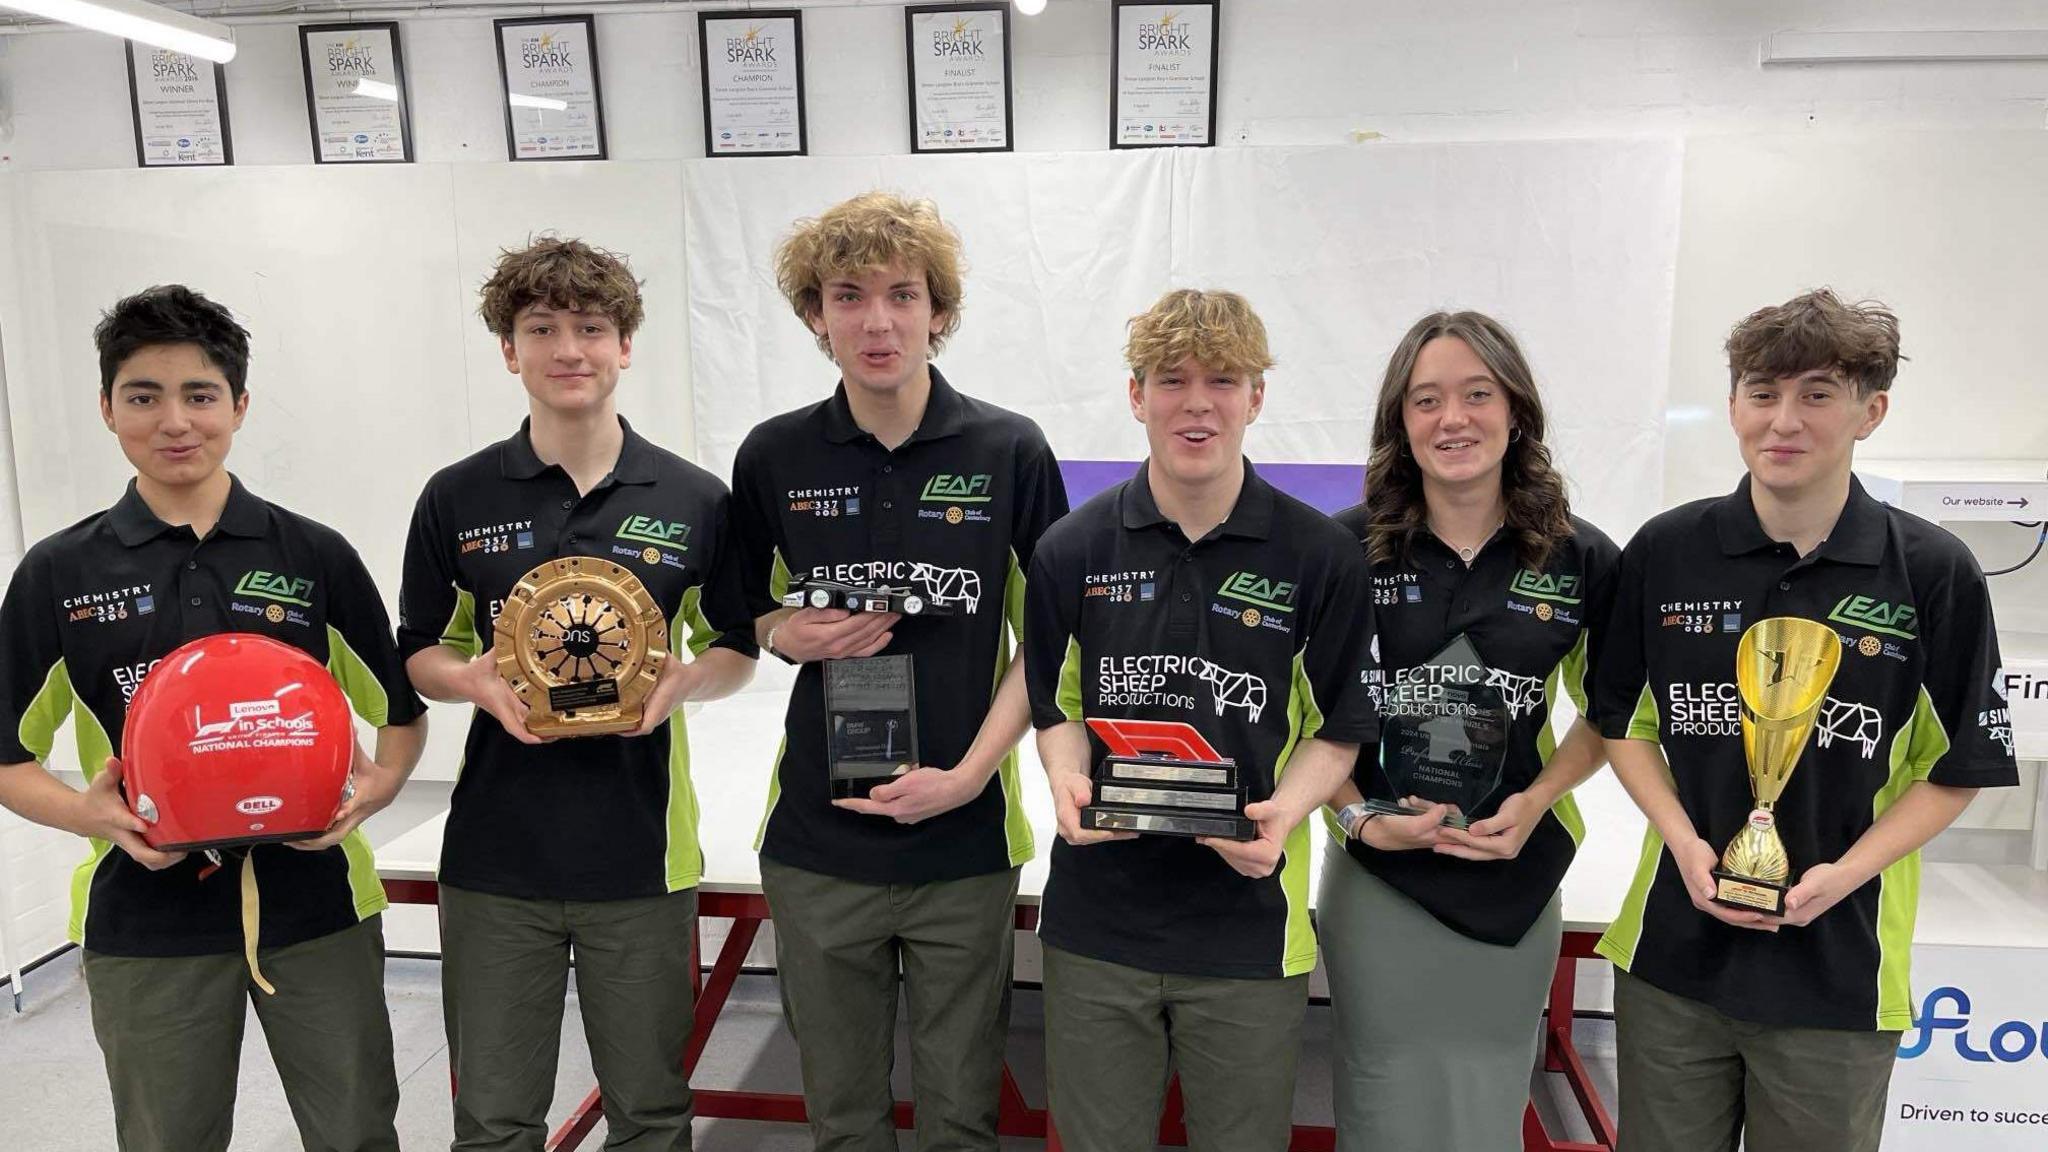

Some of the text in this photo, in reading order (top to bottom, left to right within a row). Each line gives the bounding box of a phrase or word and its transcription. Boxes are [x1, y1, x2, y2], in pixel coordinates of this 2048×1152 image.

[934, 29, 983, 42] BRIGHT
[1139, 23, 1190, 36] BRIGHT
[522, 42, 569, 55] BRIGHT
[727, 37, 775, 49] BRIGHT
[934, 41, 984, 56] SPARK
[1139, 35, 1190, 50] SPARK
[523, 53, 573, 69] SPARK
[727, 48, 776, 62] SPARK
[153, 64, 198, 77] SPARK
[328, 57, 375, 71] SPARK
[944, 69, 976, 77] FINALIST
[160, 85, 194, 94] WINNER
[336, 80, 360, 88] WIN
[788, 486, 859, 498] CHEMISTRY
[1942, 496, 2004, 505] Our website
[918, 509, 945, 520] Rotary
[458, 520, 532, 541] CHEMISTRY
[612, 545, 641, 558] Rotary
[1086, 571, 1155, 583] CHEMISTRY
[1373, 573, 1417, 586] MISTRY
[63, 584, 151, 608] CHEMISTRY
[232, 602, 264, 616] Rotary
[1212, 603, 1241, 619] Rotary
[1507, 601, 1534, 614] Rotary
[1660, 600, 1742, 613] CHEMISTRY
[1840, 634, 1858, 647] ary
[1099, 655, 1198, 676] ELECTRIC
[1382, 664, 1481, 688] LECTRIC
[1099, 674, 1166, 693] SHEEP
[1384, 684, 1444, 705] HEEP
[1669, 683, 1738, 702] ELEC
[235, 704, 275, 714] Lenovo
[1379, 703, 1478, 718] RODUCTIONS
[239, 716, 314, 731] in Schools
[1671, 722, 1741, 736] PRODUC
[193, 738, 314, 754] NATIONAL CHAMPIONS
[1418, 765, 1460, 779] NATIONAL
[1413, 772, 1463, 788] CHAMPIONS
[243, 800, 276, 810] BELL
[1900, 1103, 1964, 1122] Driven
[1970, 1108, 1989, 1122] to
